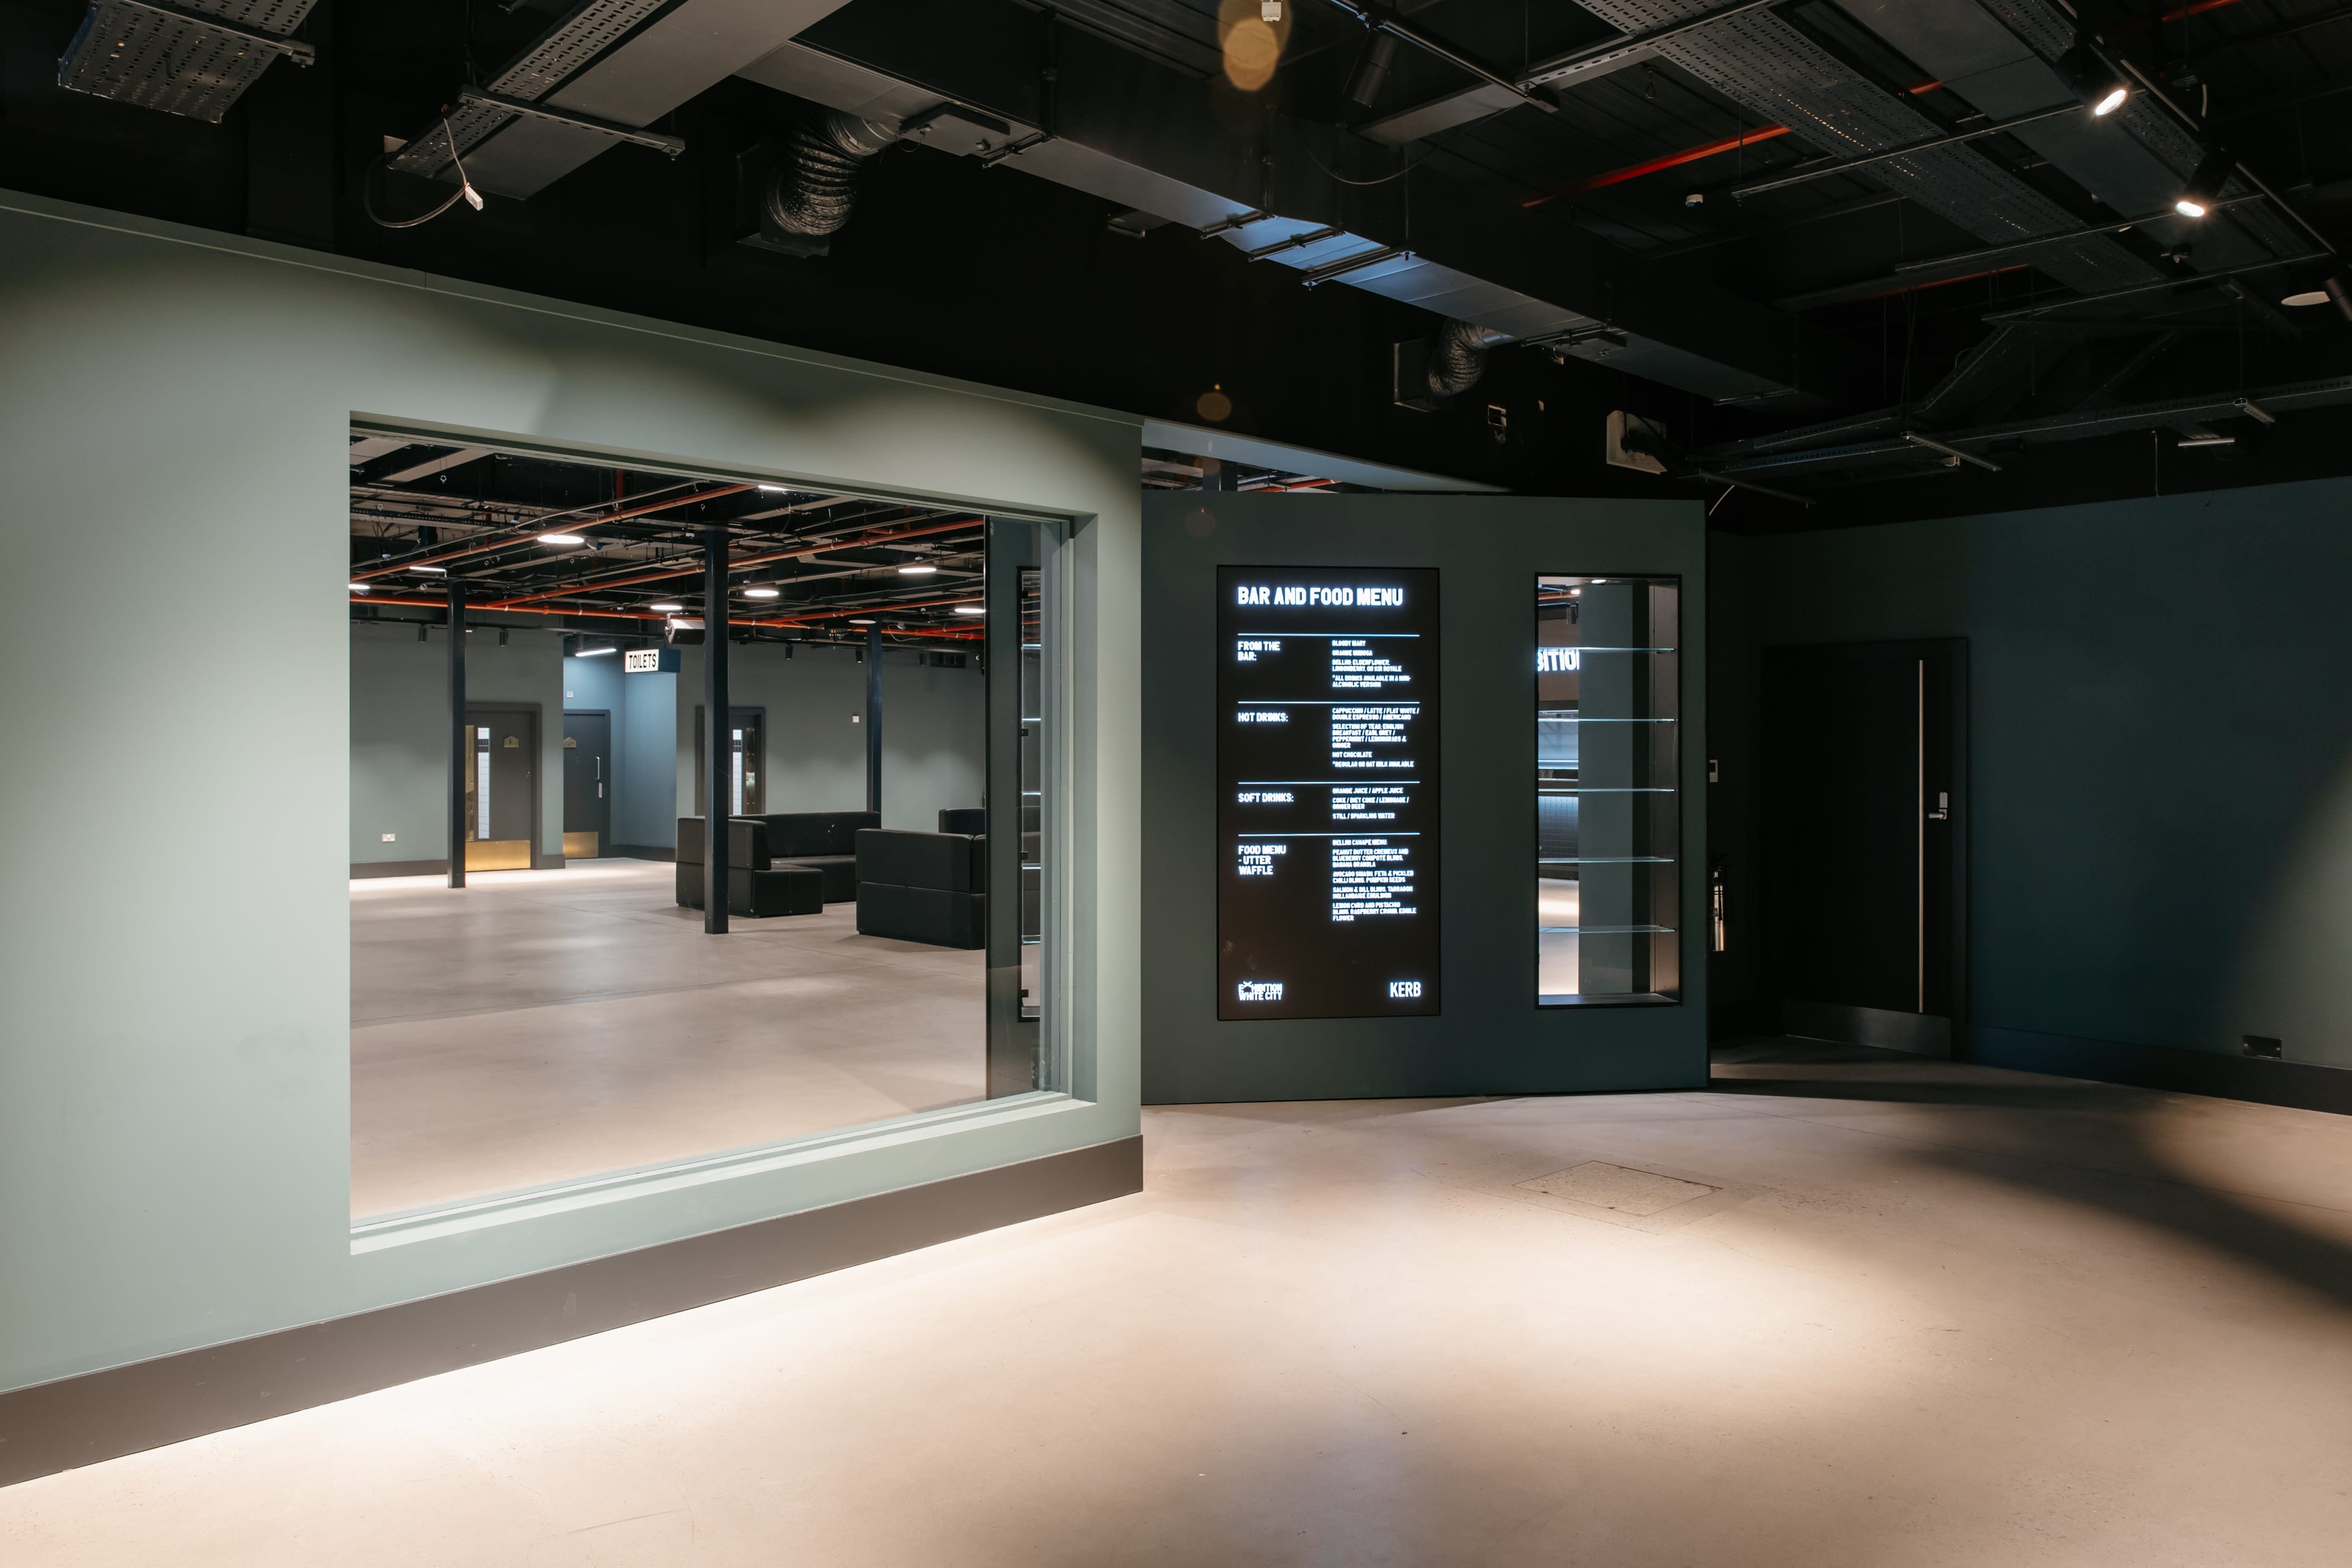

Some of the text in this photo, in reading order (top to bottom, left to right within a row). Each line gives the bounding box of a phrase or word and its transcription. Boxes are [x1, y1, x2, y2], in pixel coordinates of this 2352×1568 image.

[1238, 586, 1403, 606] BAR AND FOOD MENU
[1237, 641, 1280, 651] FROM THE
[629, 654, 657, 669] TOILETS
[1237, 652, 1257, 662] BAR:
[1238, 712, 1288, 722] HOT DRINKS:
[1238, 793, 1294, 802] SOFT DRINKS:
[1238, 845, 1286, 854] FOOD MENU
[1243, 856, 1272, 865] UTTER
[1238, 866, 1273, 875] WAFFLE
[1390, 982, 1421, 998] KERB
[1239, 992, 1281, 1000] WHITE CITY
